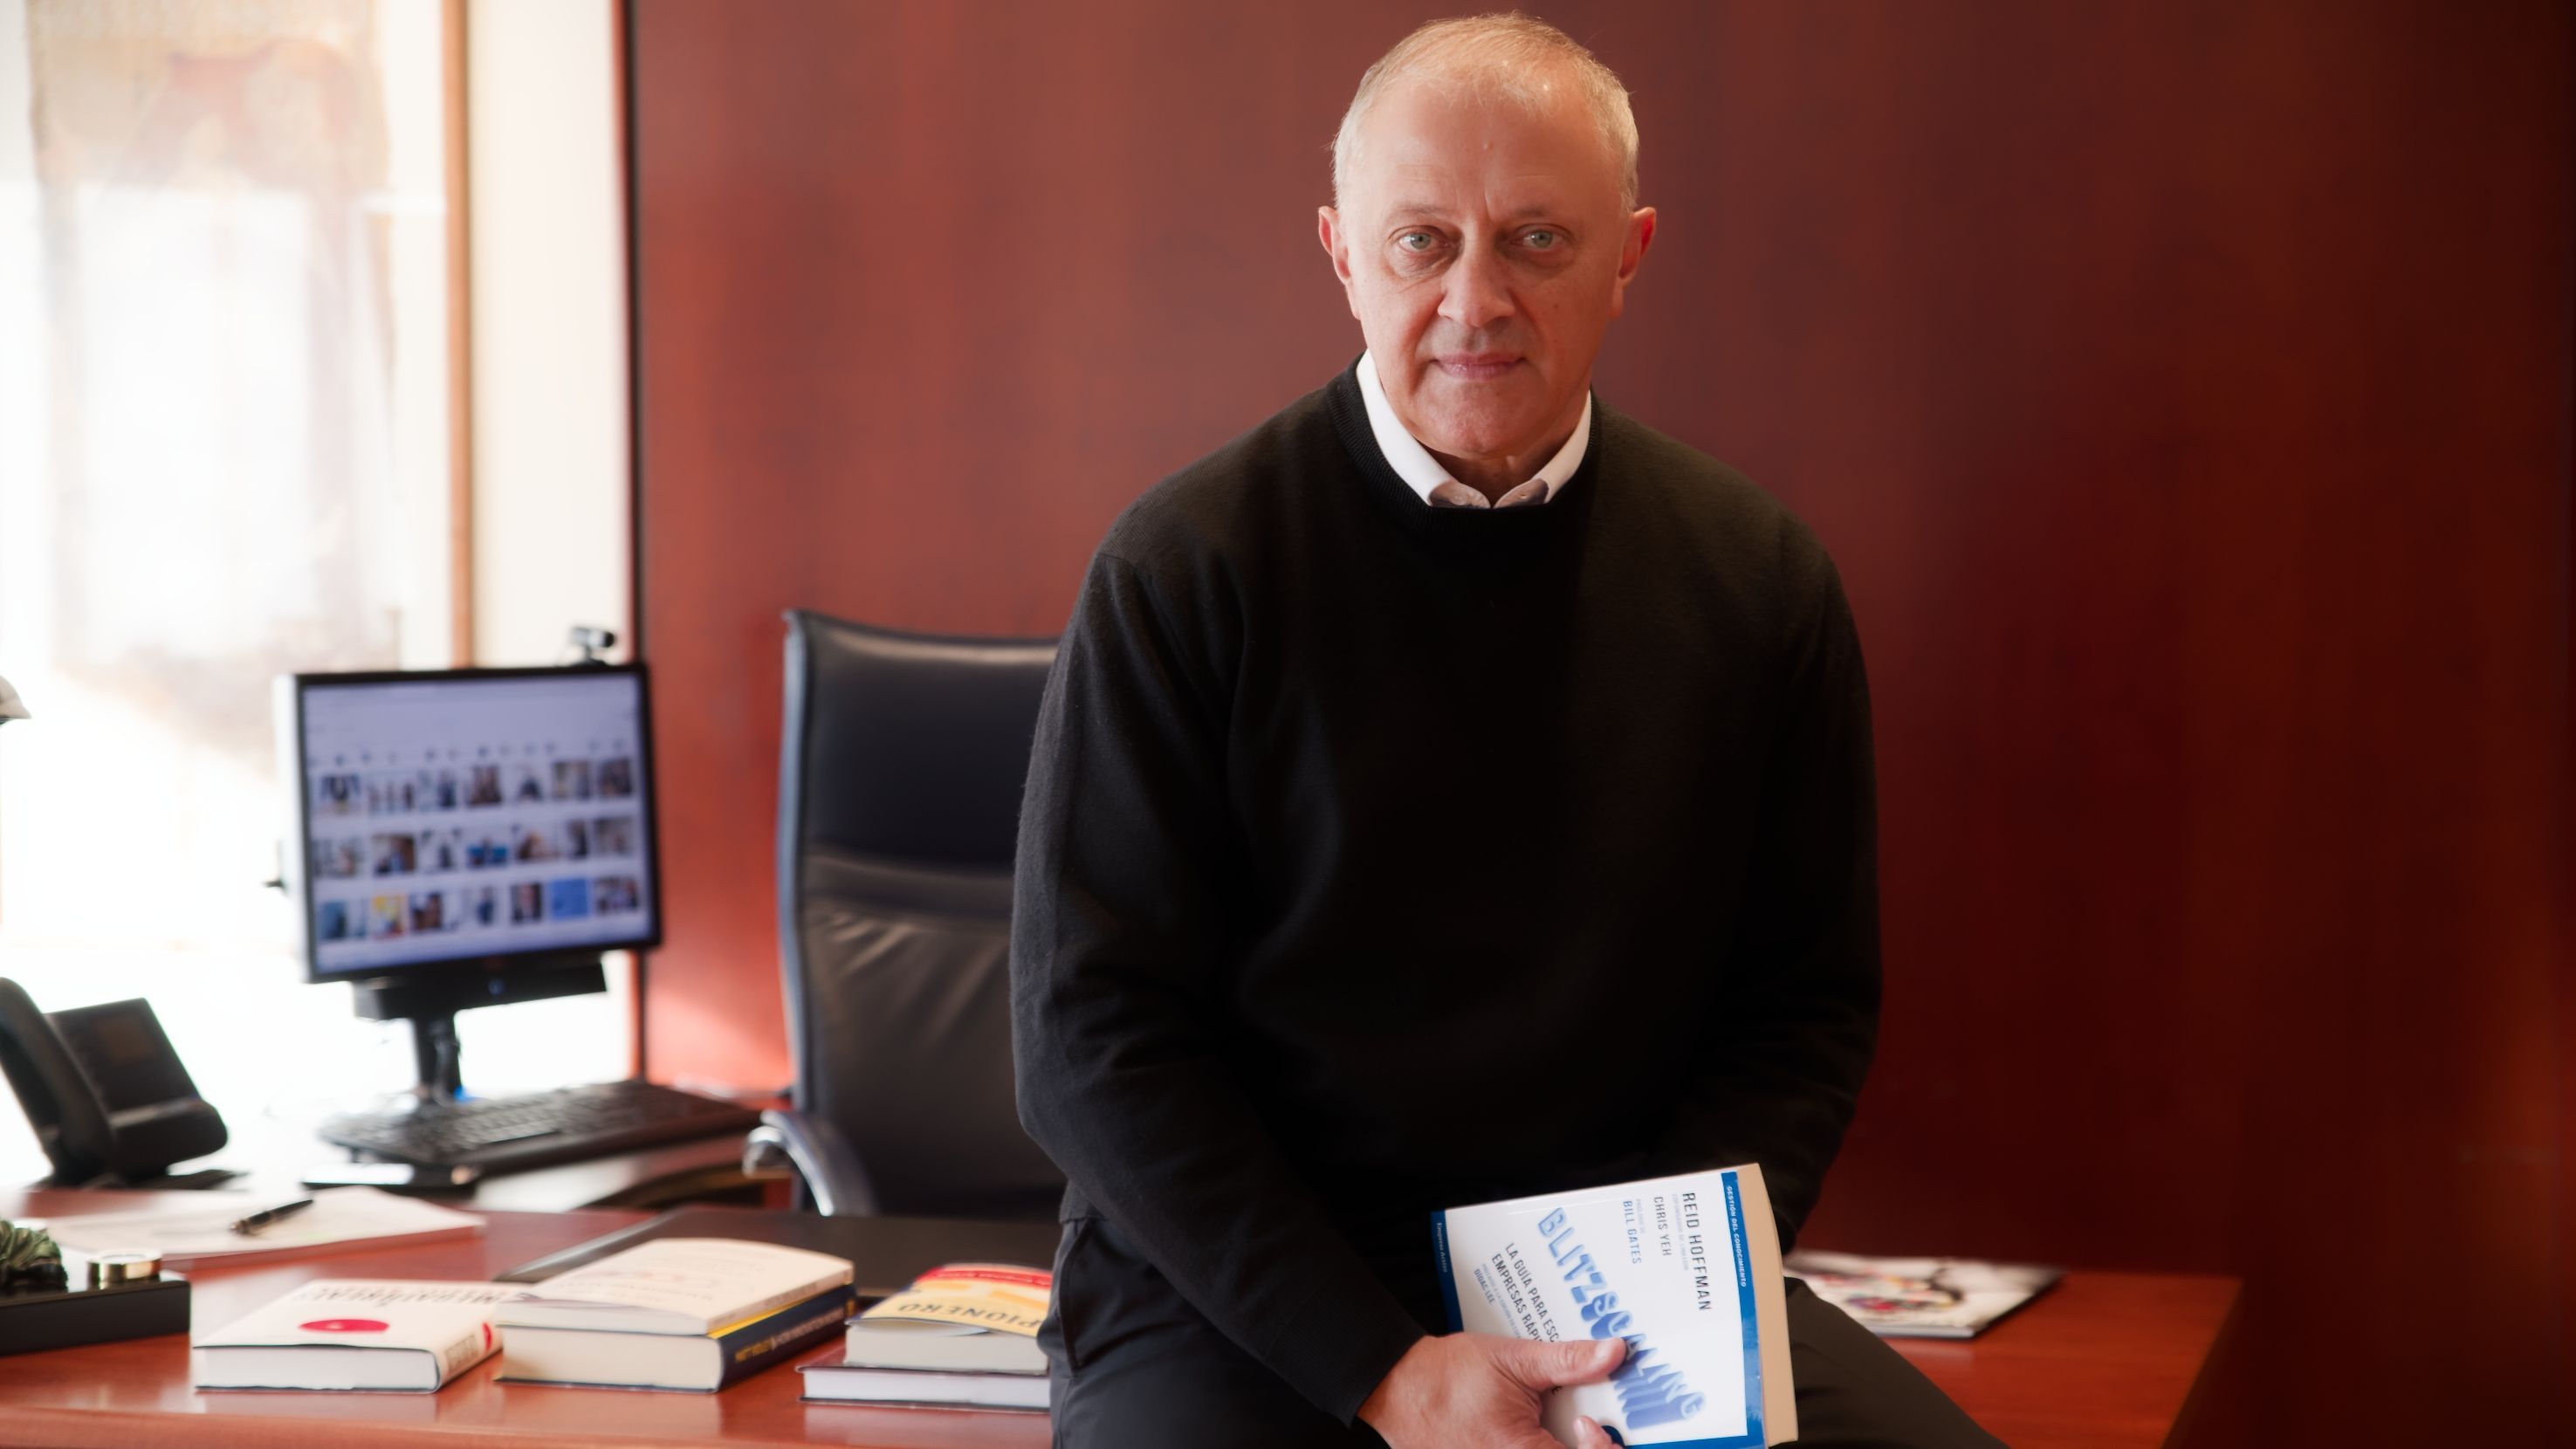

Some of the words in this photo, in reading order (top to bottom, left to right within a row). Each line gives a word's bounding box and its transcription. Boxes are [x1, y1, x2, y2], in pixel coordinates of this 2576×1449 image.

[1623, 1200, 1635, 1225] BILL
[1653, 1197, 1668, 1230] CHRIS
[1682, 1192, 1700, 1229] REID
[1727, 1185, 1736, 1216] GESTIÓN
[1731, 1218, 1740, 1232] DEL
[1627, 1229, 1641, 1264] GATES
[1659, 1234, 1672, 1256] YEH
[1734, 1233, 1747, 1288] CONOCIMIENTO
[1492, 1253, 1528, 1314] EMPRESAS
[1506, 1243, 1519, 1260] LA
[1514, 1260, 1533, 1288] GUÍA
[1528, 1288, 1548, 1320] PARA
[1688, 1234, 1712, 1310] HOFFMAN
[897, 1303, 1043, 1329] PIONERO
[1538, 1207, 1706, 1428] BLITZSCALING
